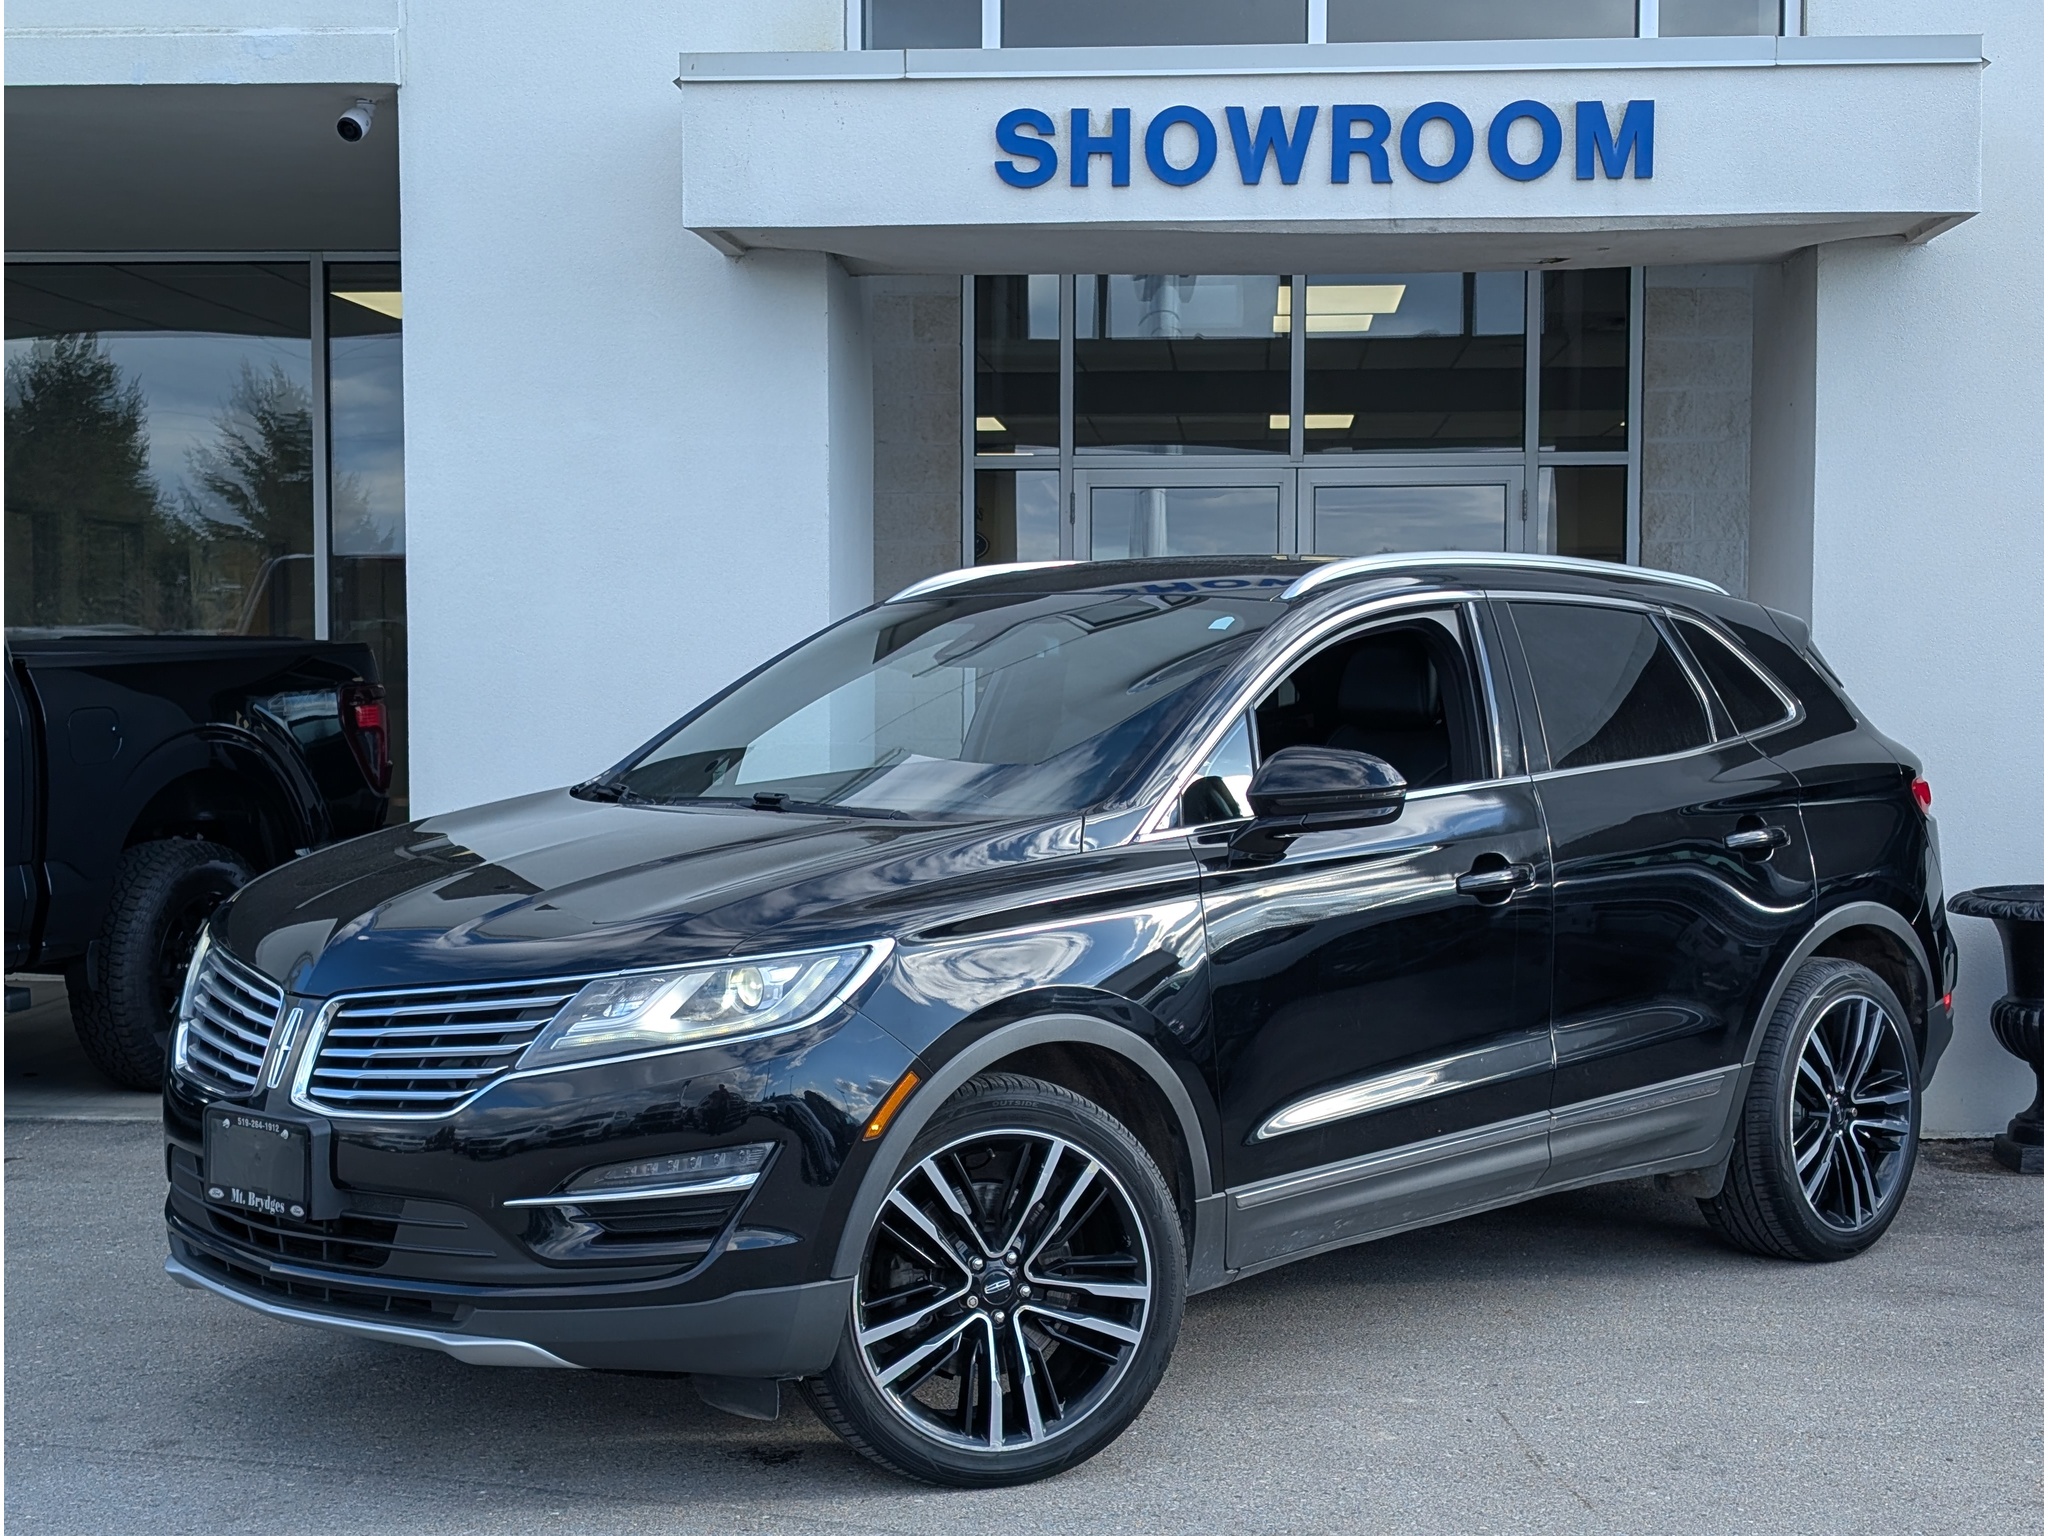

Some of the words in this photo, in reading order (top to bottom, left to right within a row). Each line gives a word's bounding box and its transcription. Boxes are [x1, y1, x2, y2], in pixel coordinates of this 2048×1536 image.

[995, 99, 1655, 188] SHOWROOM
[991, 1099, 1040, 1109] OUTSIDE
[237, 1117, 280, 1133] 519-264-1912
[231, 1187, 246, 1205] Mt.
[247, 1191, 285, 1215] Brydges
